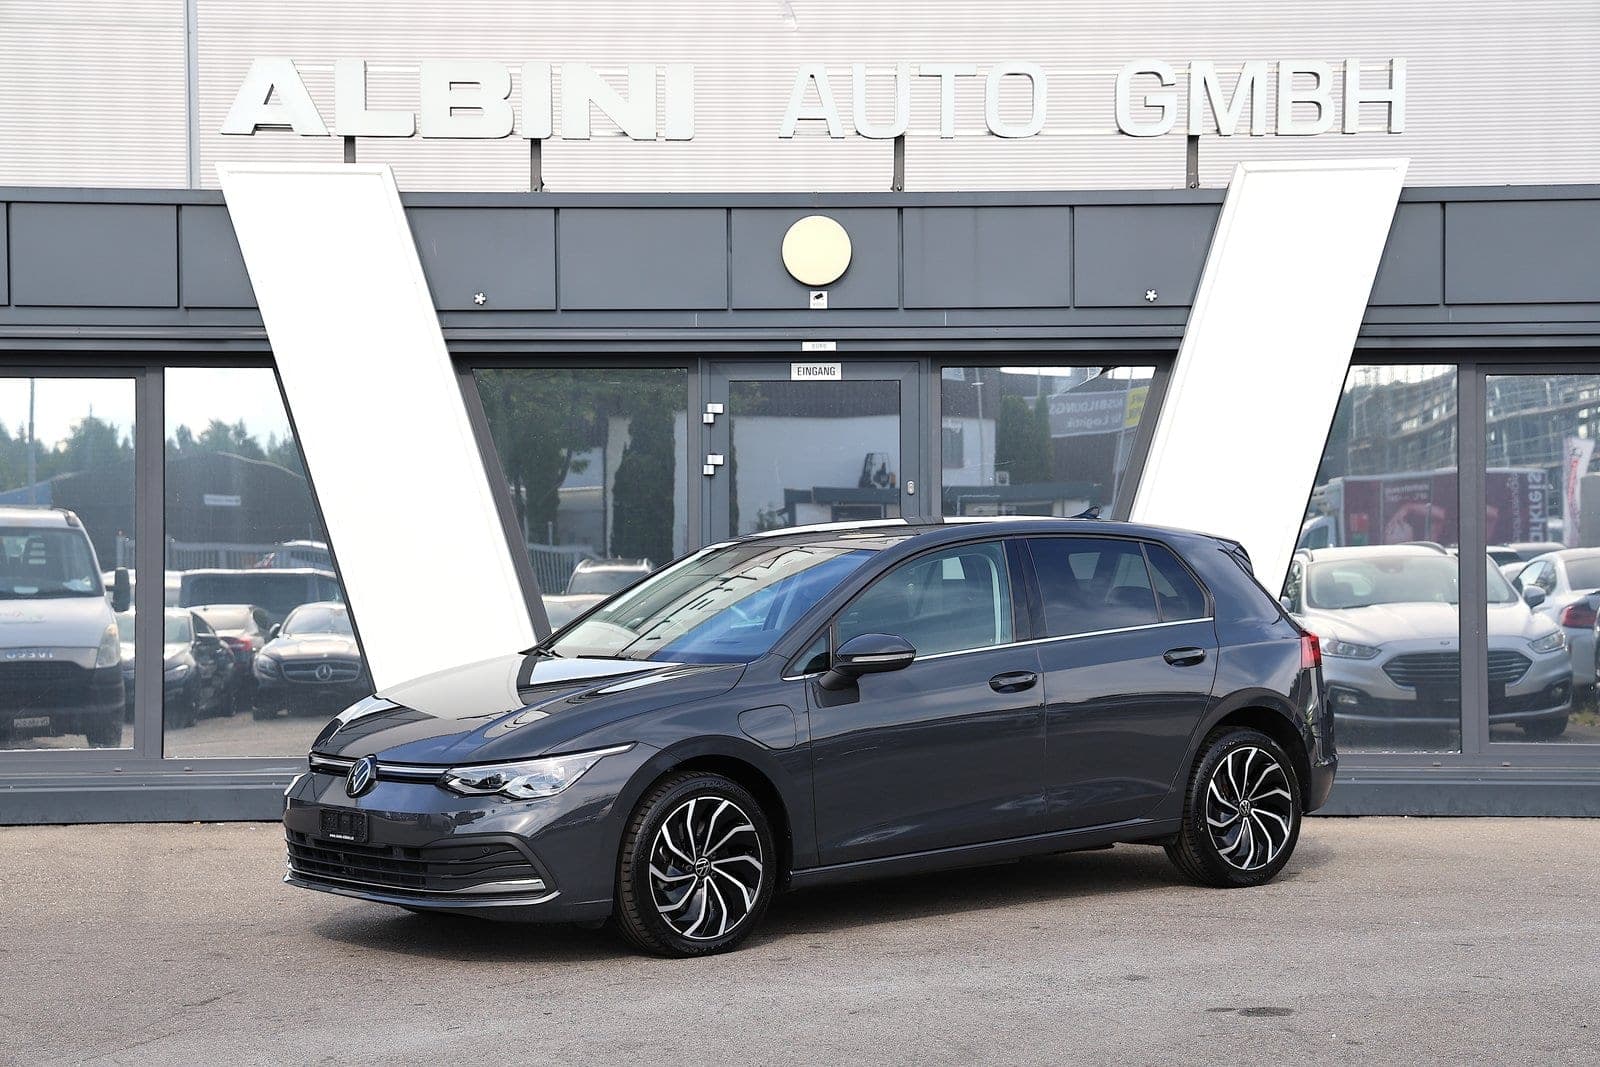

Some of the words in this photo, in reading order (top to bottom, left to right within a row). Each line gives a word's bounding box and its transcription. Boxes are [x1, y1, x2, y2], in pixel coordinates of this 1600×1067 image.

[220, 57, 695, 141] ALBINI
[778, 60, 1047, 139] AUTO
[1114, 57, 1408, 137] GMBH
[797, 366, 836, 376] EINGANG
